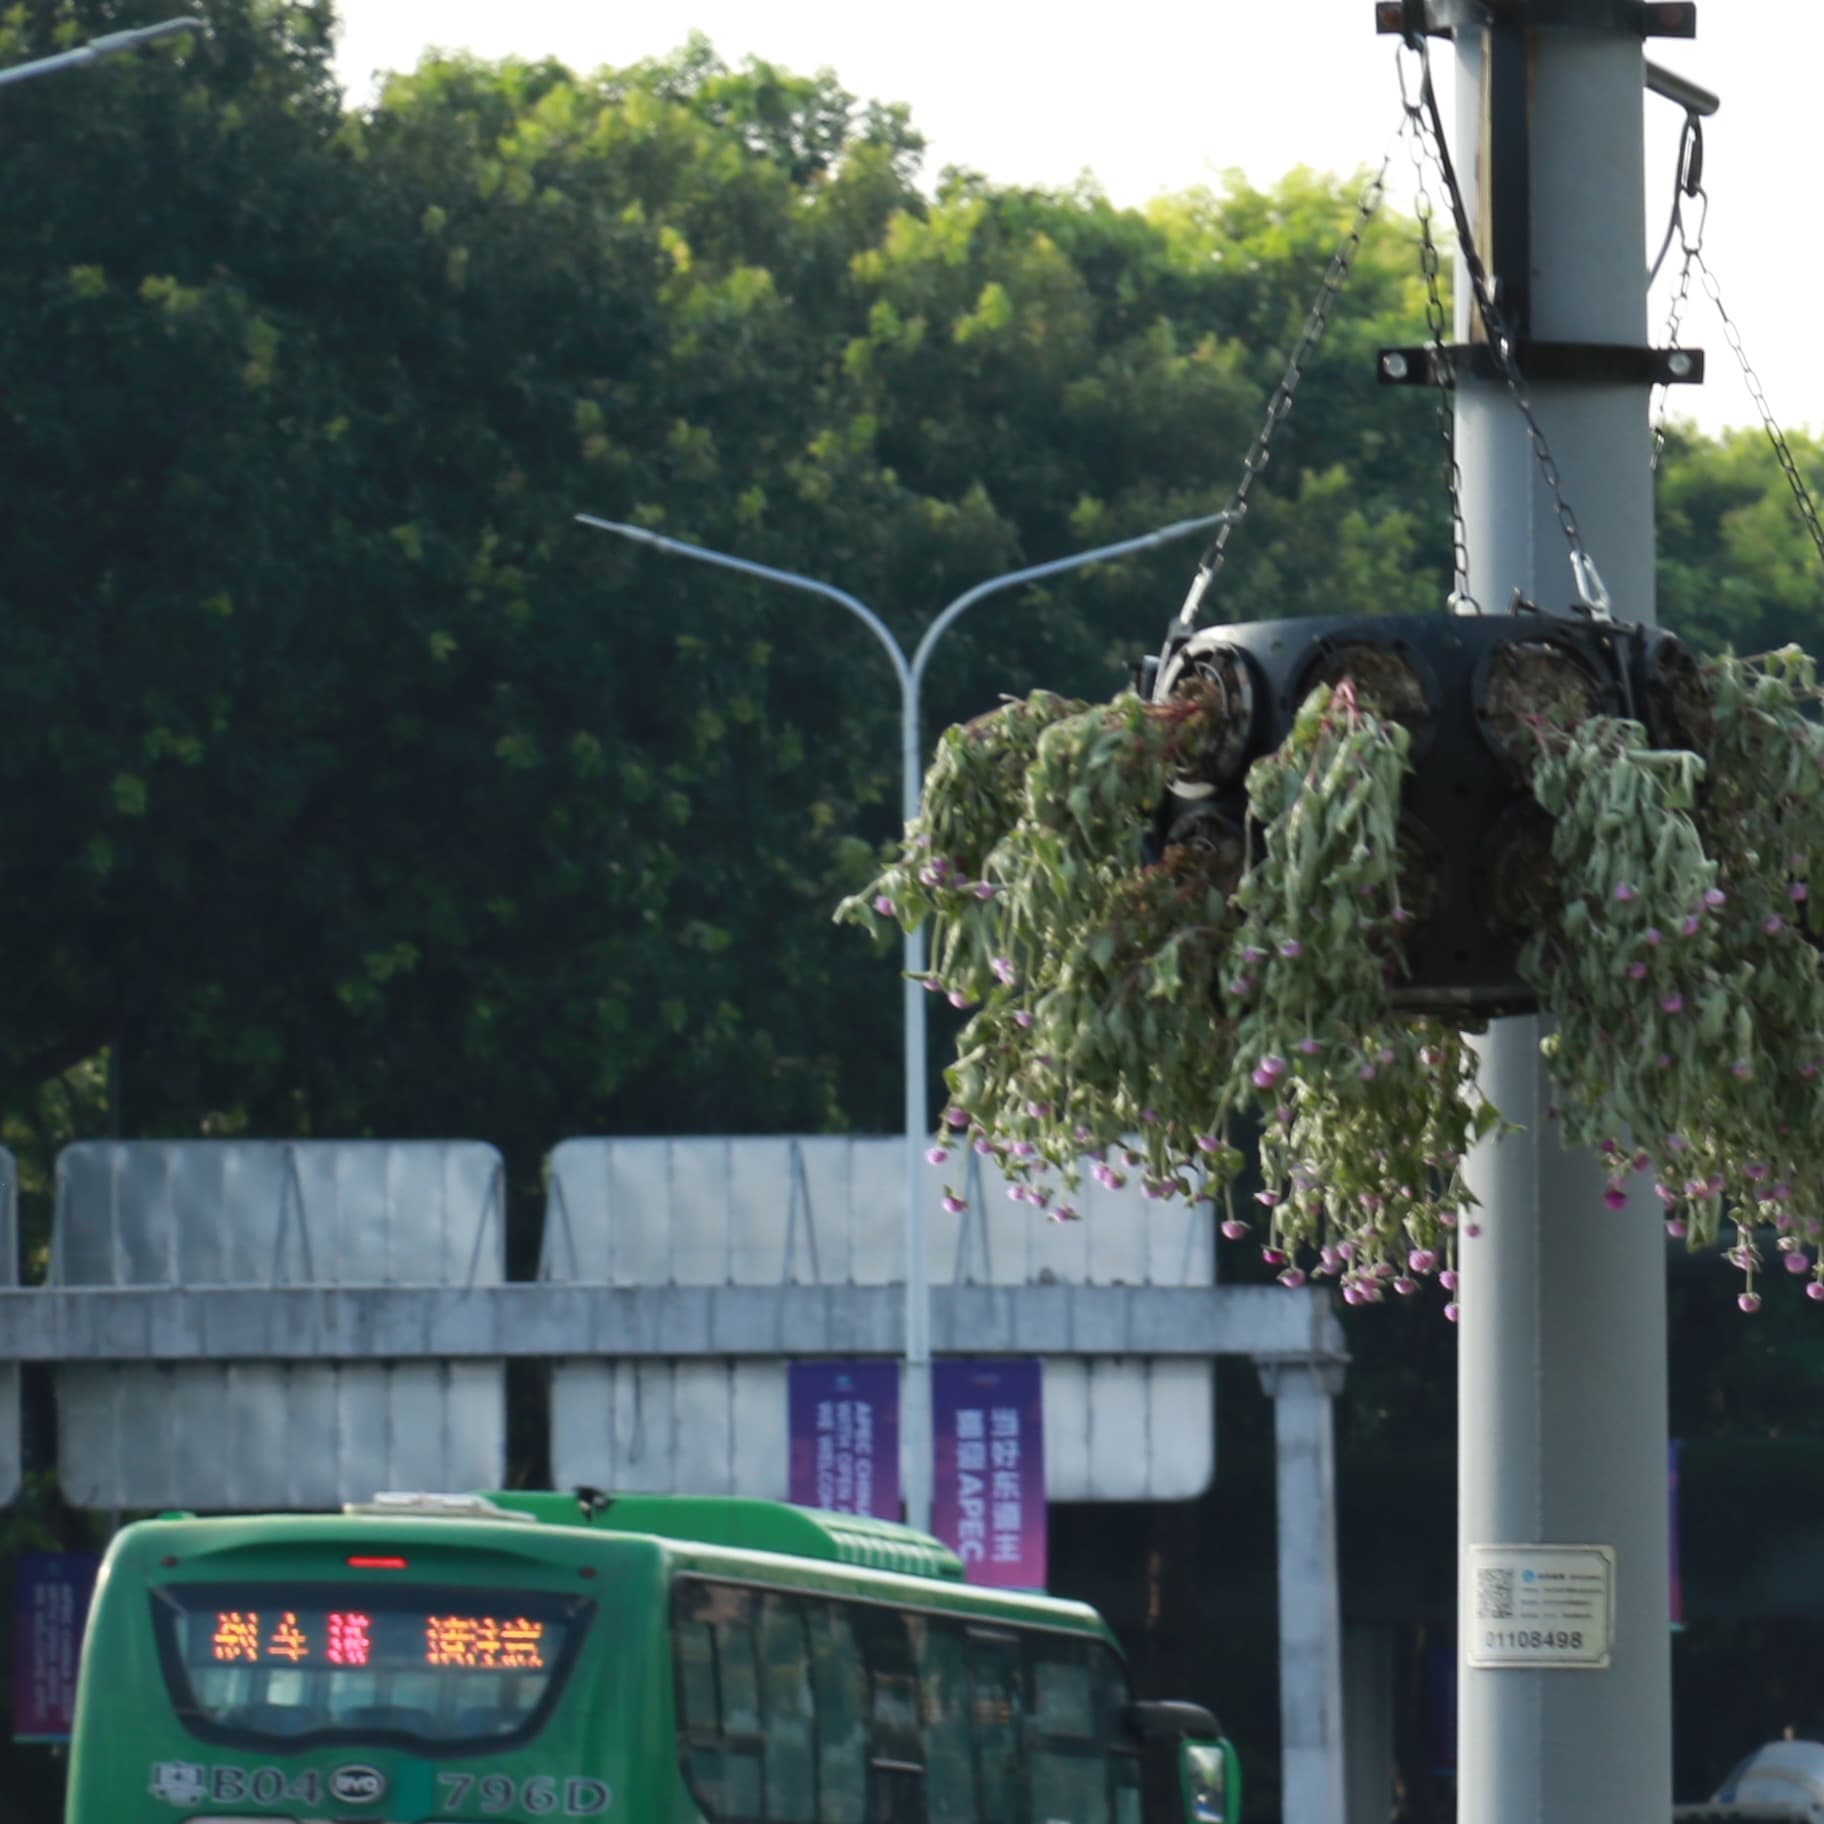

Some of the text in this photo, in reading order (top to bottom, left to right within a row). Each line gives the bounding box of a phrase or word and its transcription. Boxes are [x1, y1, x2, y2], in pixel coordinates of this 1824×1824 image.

[1486, 1630, 1583, 1649] 01108498
[335, 1775, 378, 1792] BYD
[436, 1773, 611, 1816] 796D
